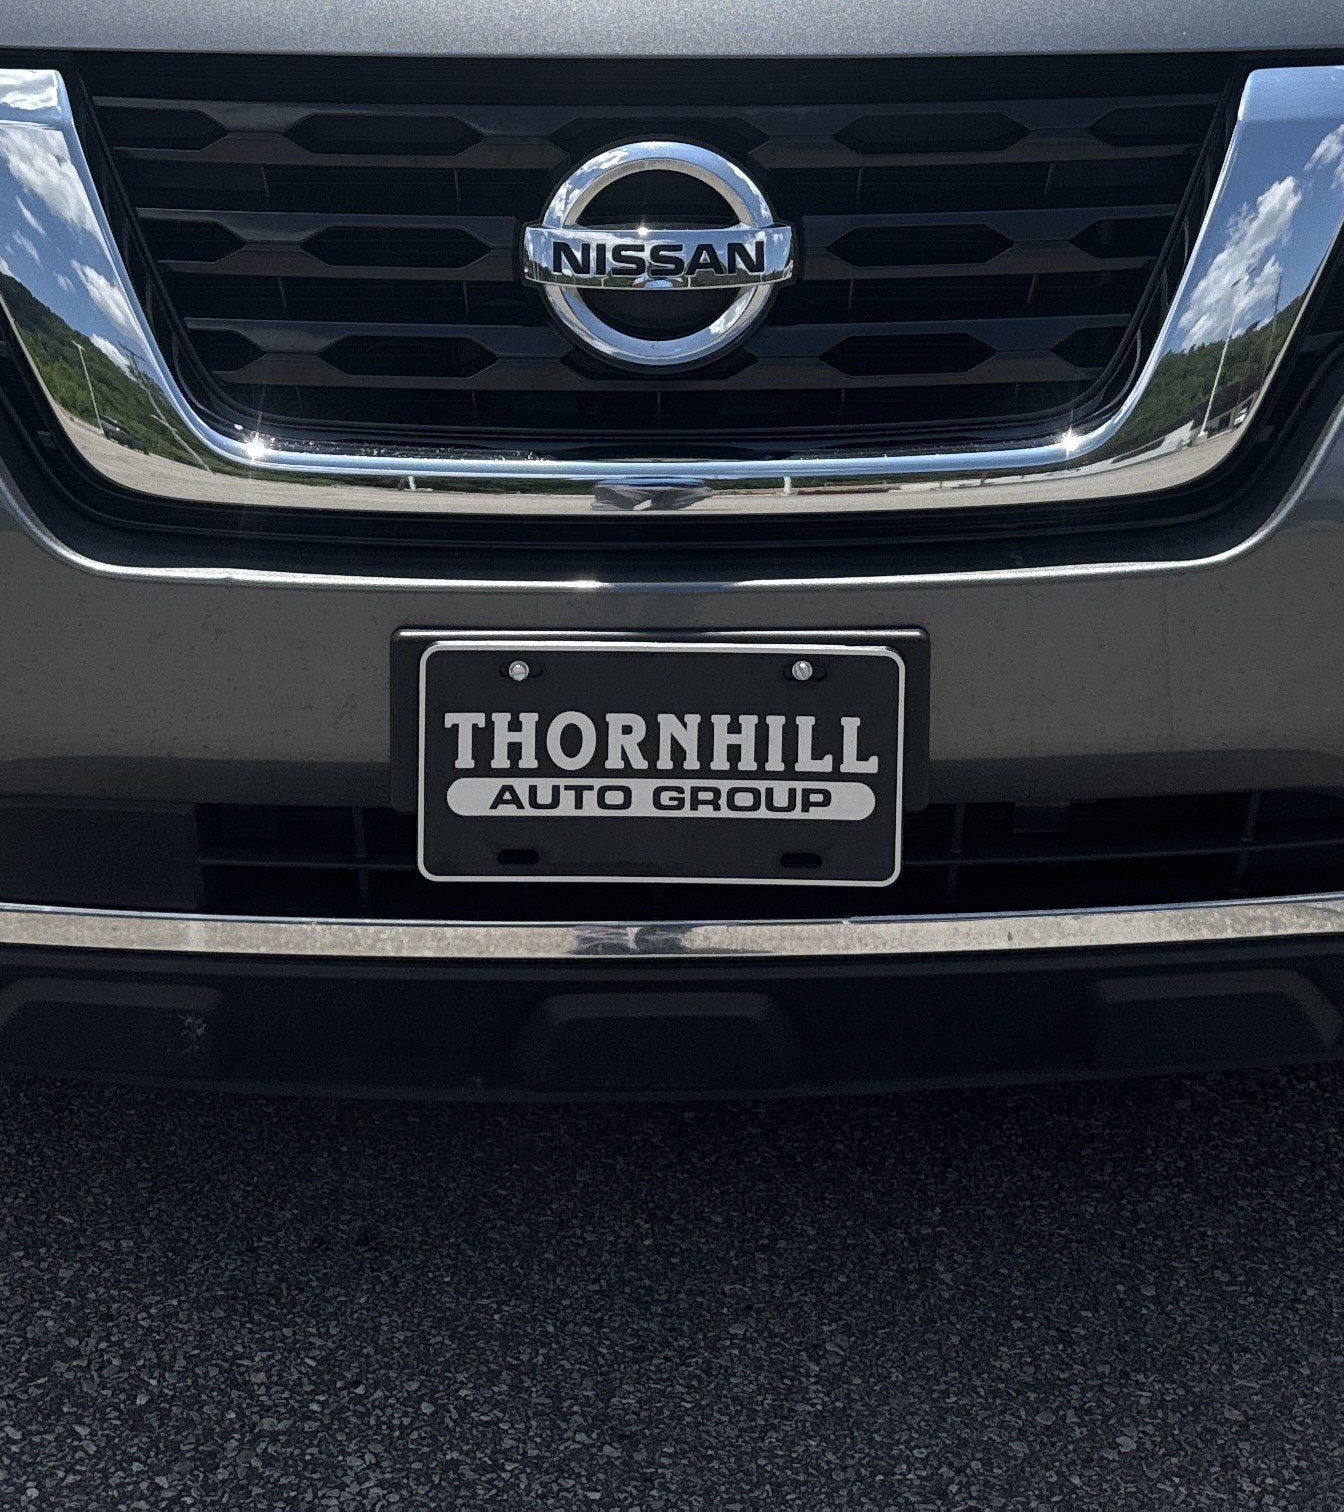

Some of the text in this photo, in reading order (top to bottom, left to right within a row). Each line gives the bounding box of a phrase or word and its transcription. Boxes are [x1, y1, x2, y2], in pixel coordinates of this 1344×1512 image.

[552, 241, 766, 277] NISSAN
[444, 710, 879, 774] THORNHILL
[489, 784, 833, 814] AUTO GROUP
